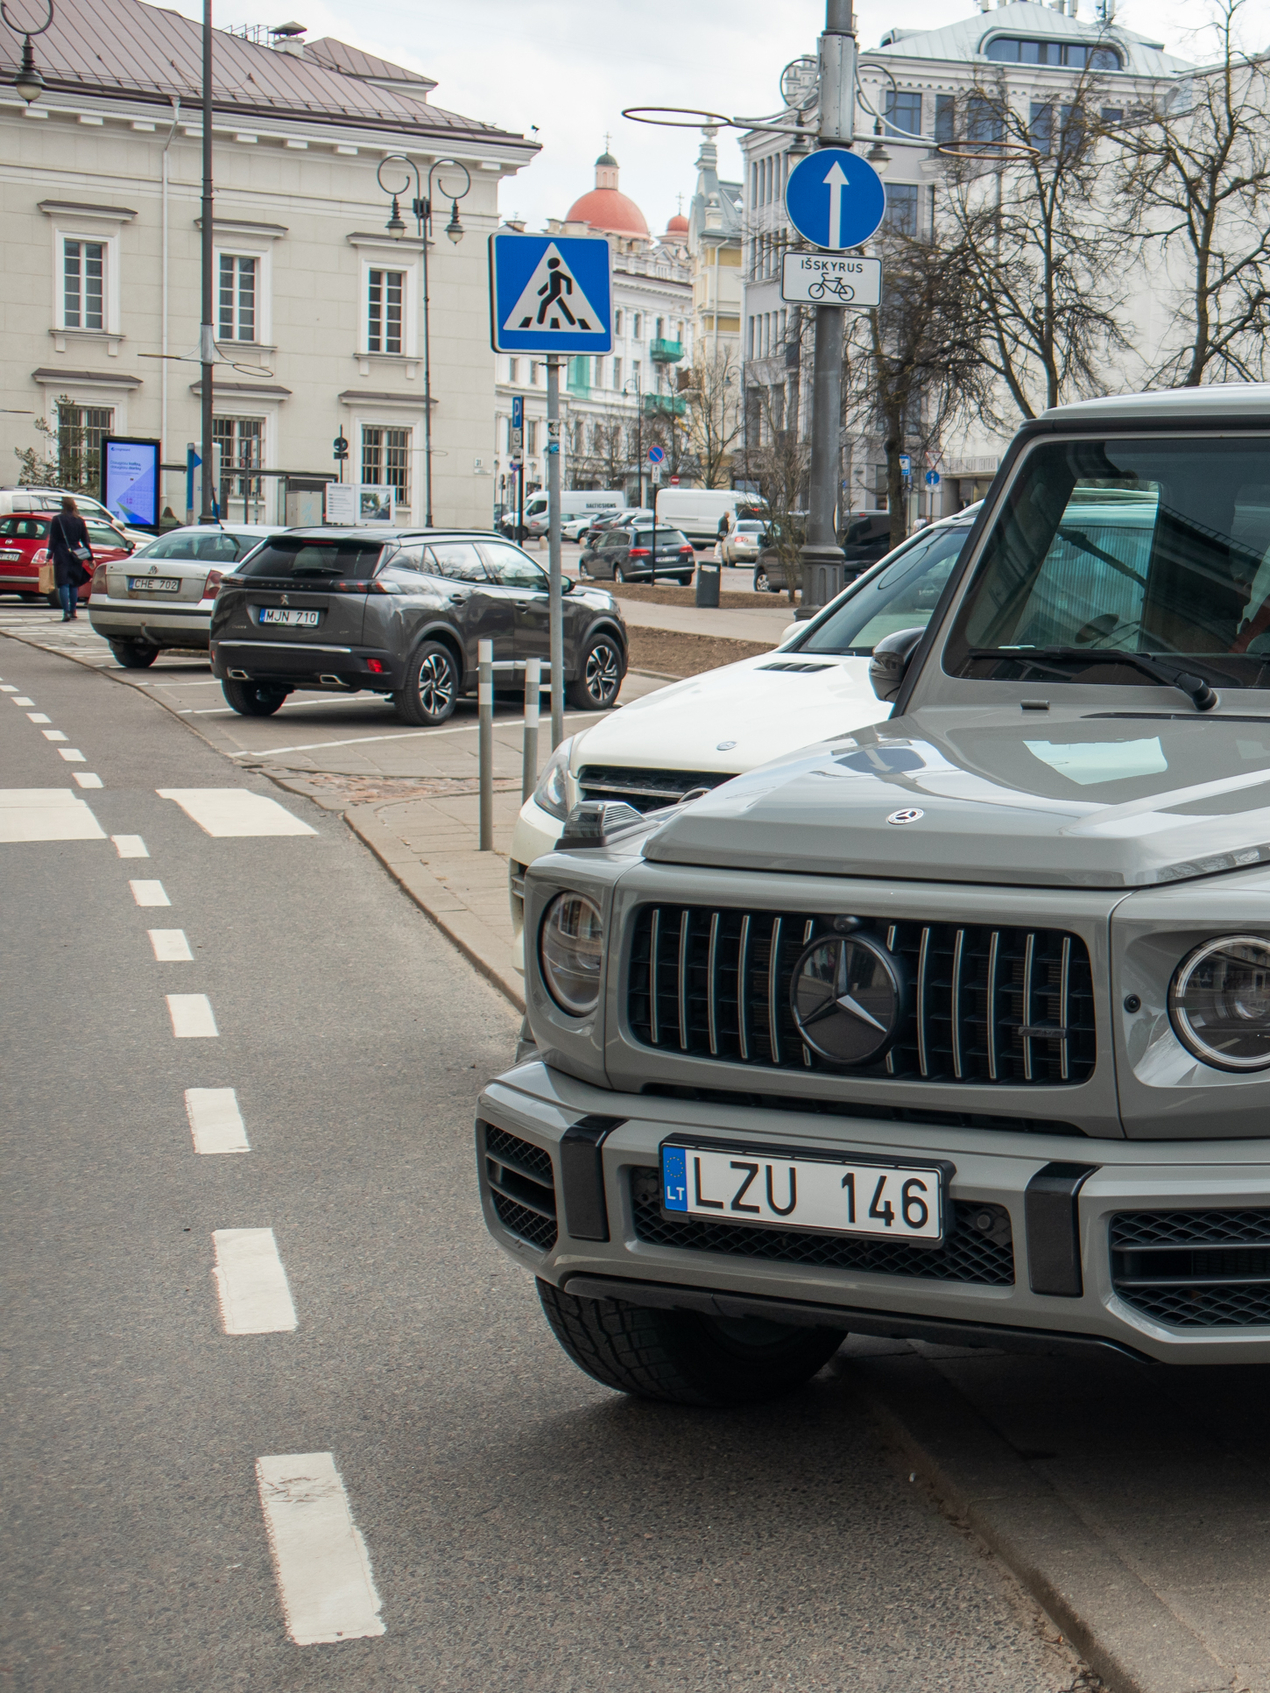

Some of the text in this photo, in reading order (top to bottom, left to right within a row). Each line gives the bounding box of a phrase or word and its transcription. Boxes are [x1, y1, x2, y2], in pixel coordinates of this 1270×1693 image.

[801, 257, 863, 273] IŠSKYRUS
[134, 579, 178, 590] CHE 702
[266, 611, 316, 623] MJN 710
[666, 1186, 685, 1201] LT
[693, 1157, 930, 1230] LZU 146
